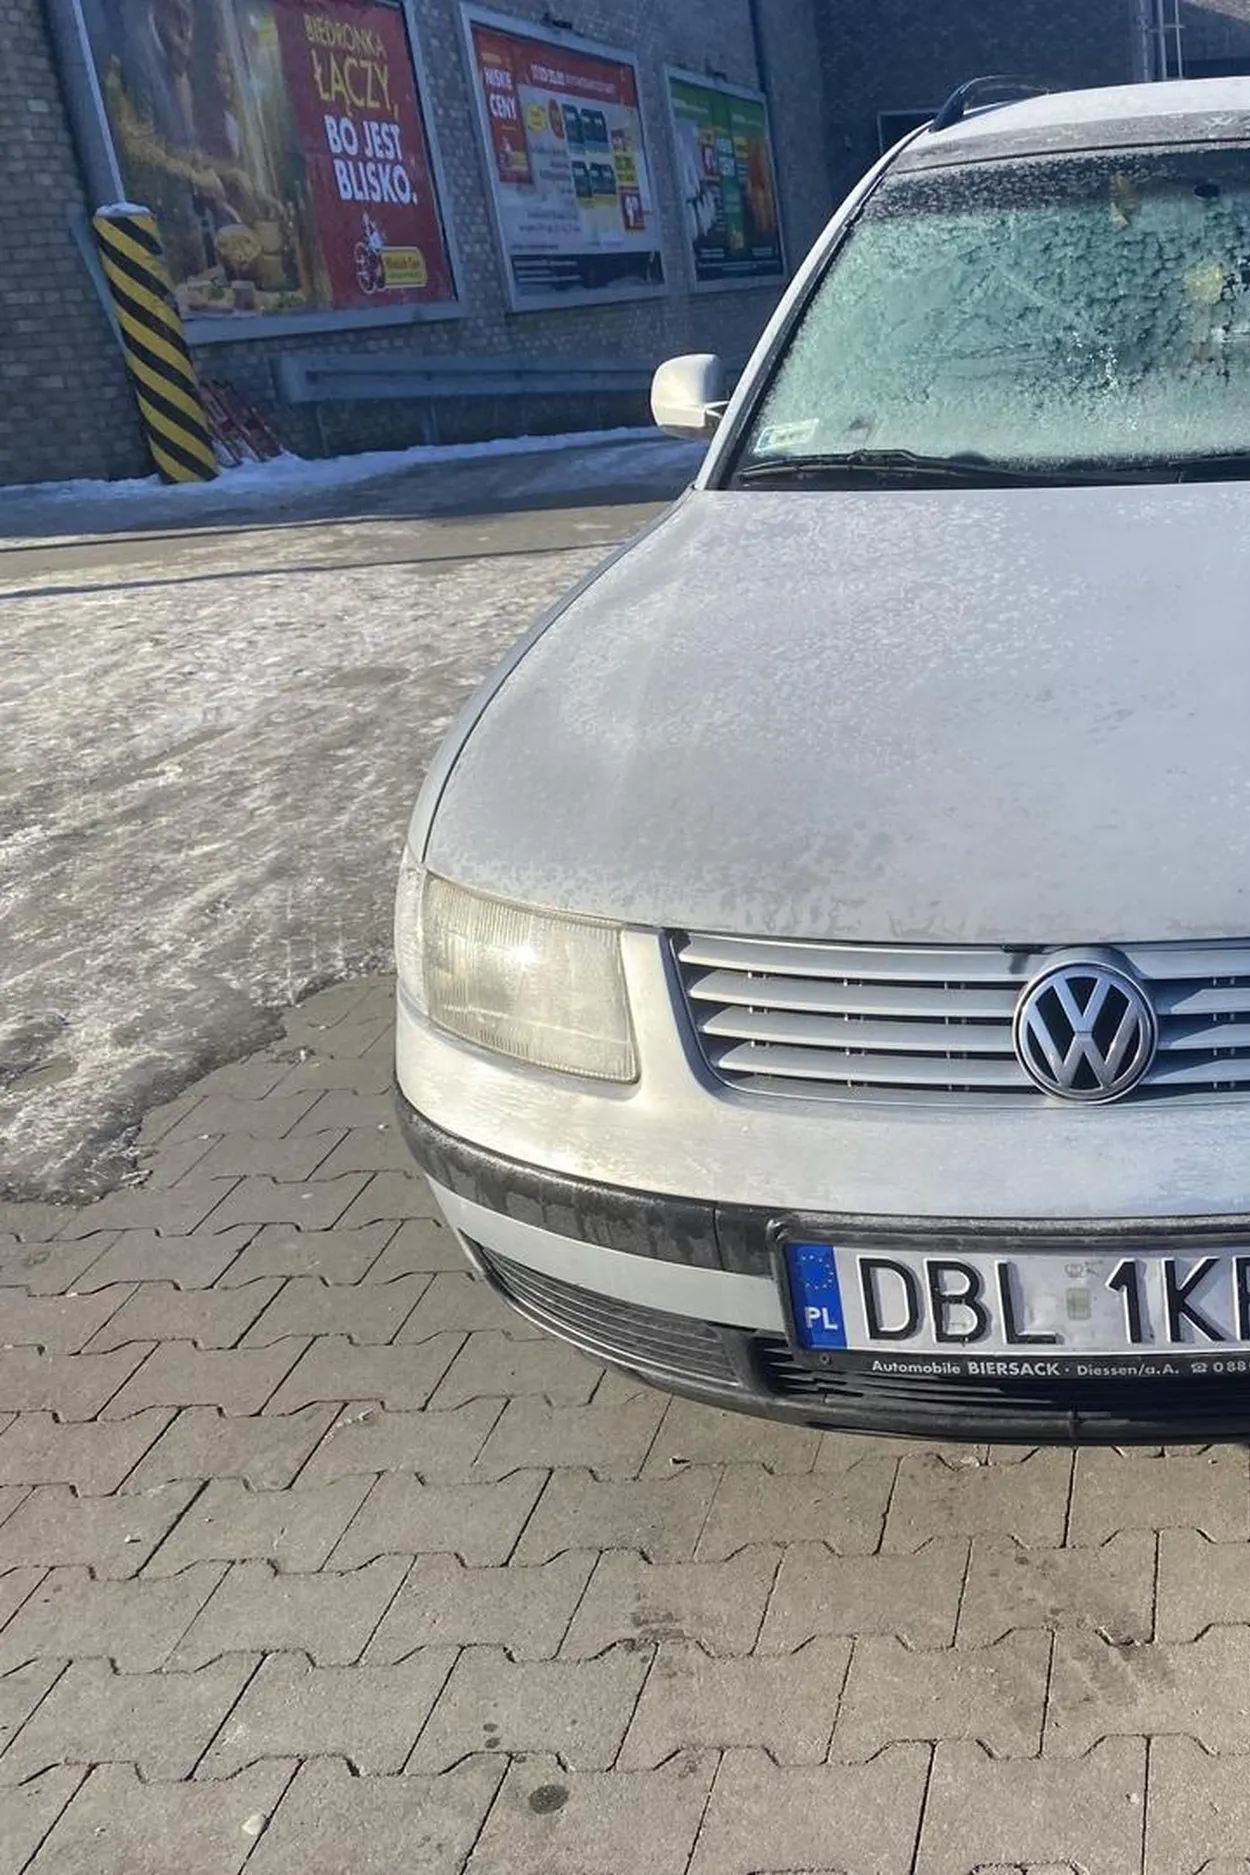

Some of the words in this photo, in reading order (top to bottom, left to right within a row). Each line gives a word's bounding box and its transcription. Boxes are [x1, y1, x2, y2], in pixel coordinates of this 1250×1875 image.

[489, 93, 517, 120] CENY
[325, 115, 358, 156] BO
[363, 120, 402, 161] JEST
[333, 159, 417, 205] BLISKO.
[857, 1256, 1062, 1344] DBL
[804, 1307, 838, 1330] PL
[872, 1360, 961, 1375] Automobile
[967, 1360, 1060, 1376] BIERSACK
